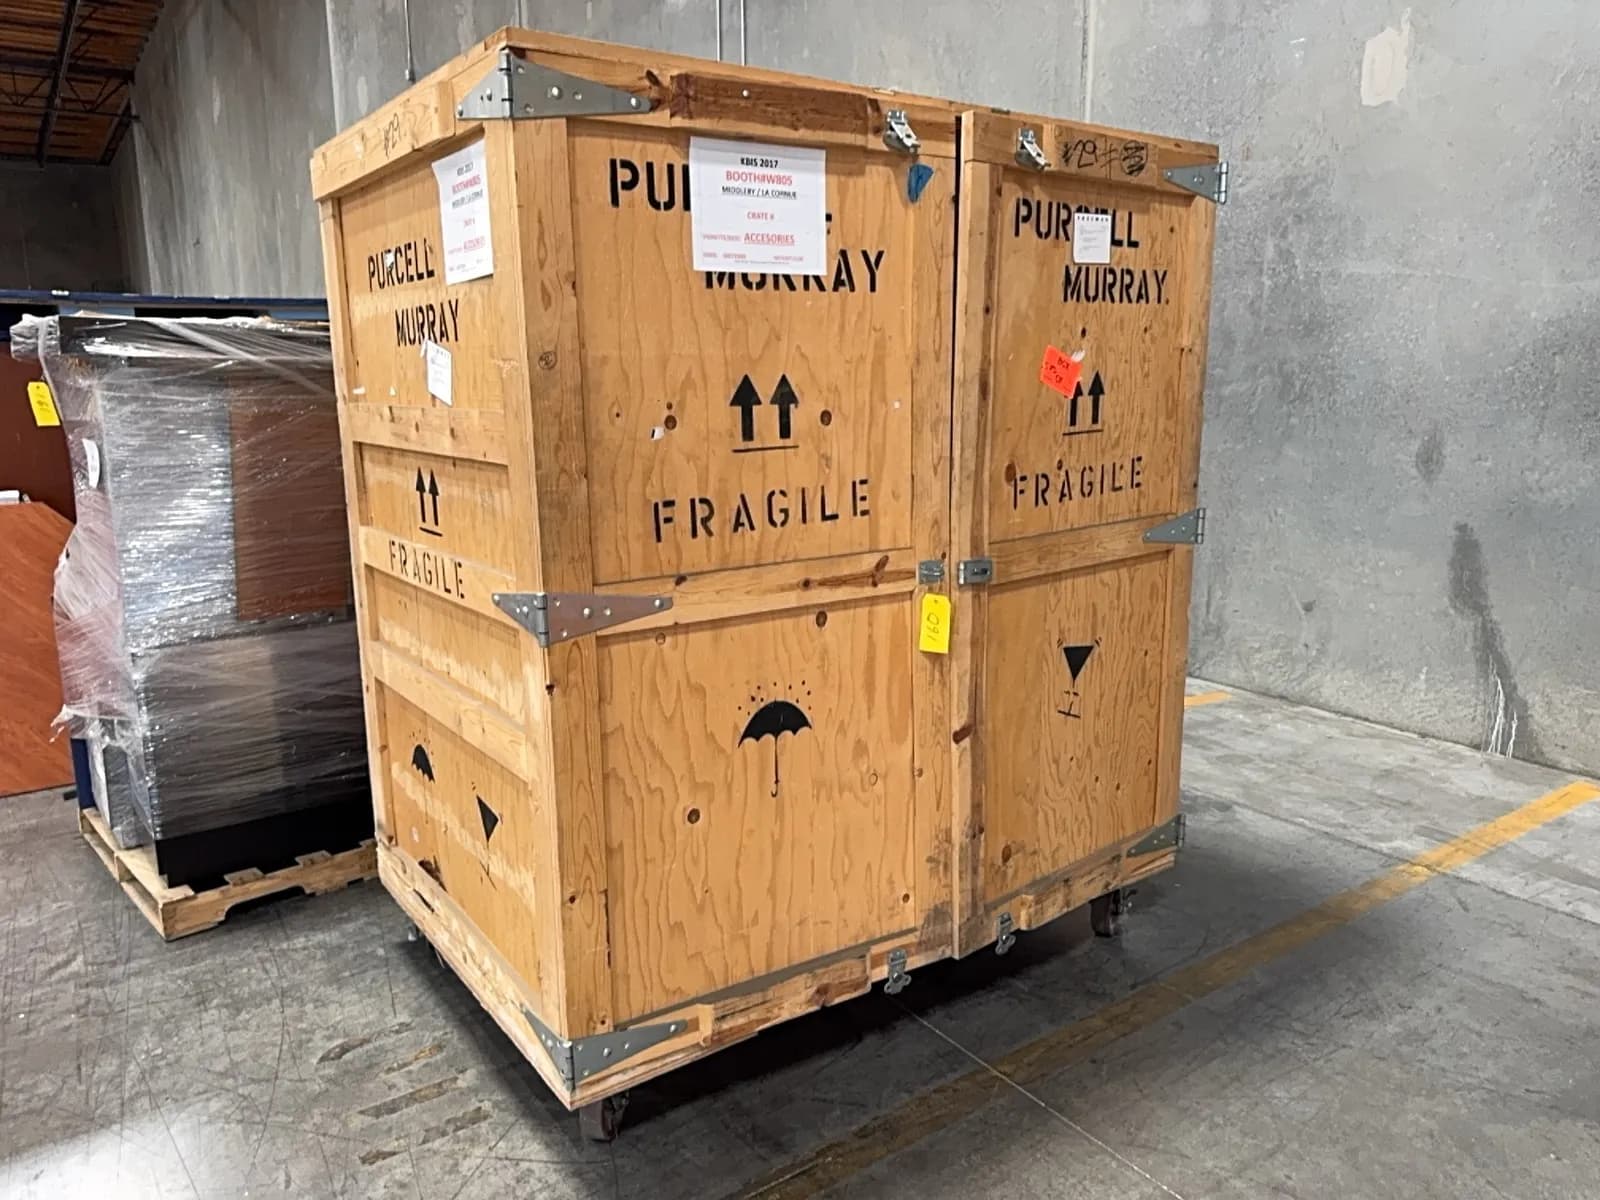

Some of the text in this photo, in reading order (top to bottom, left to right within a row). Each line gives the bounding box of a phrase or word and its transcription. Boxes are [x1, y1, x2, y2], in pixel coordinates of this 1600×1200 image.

[759, 158, 779, 169] 2017
[1014, 197, 1140, 248] PURLL
[395, 298, 460, 347] MURRAY
[1013, 456, 1142, 511] FRAGILE
[653, 478, 870, 543] FRAGILE
[388, 540, 466, 599] FRAGILE
